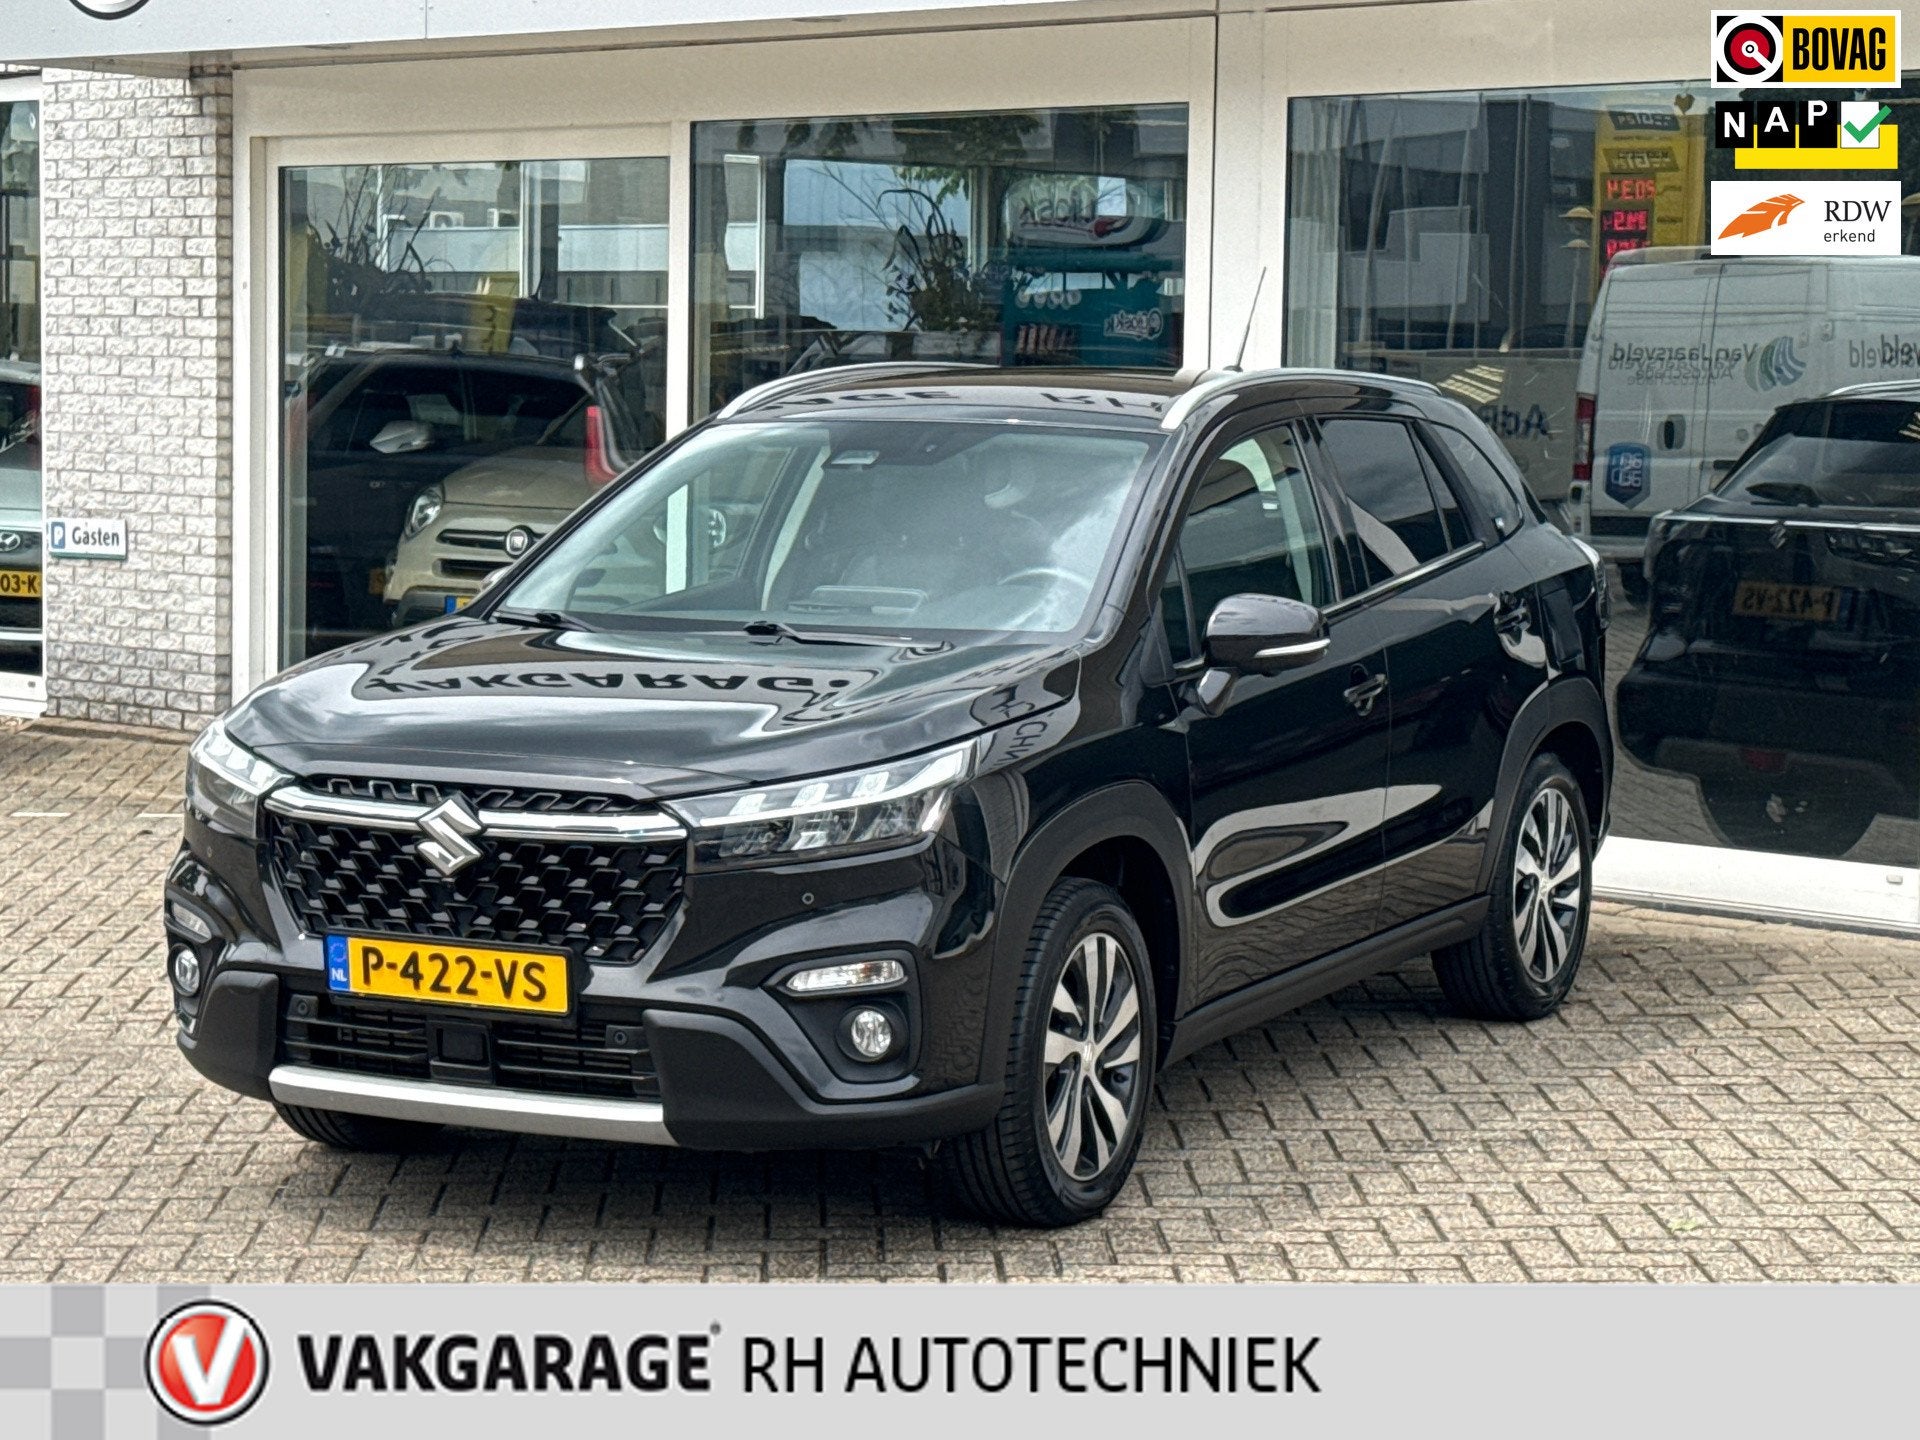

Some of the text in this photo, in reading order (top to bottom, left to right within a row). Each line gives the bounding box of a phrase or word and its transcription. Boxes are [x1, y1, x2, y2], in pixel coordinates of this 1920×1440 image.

[72, 526, 119, 546] Gasten
[331, 968, 347, 982] NL
[361, 945, 547, 1002] P-422-VS
